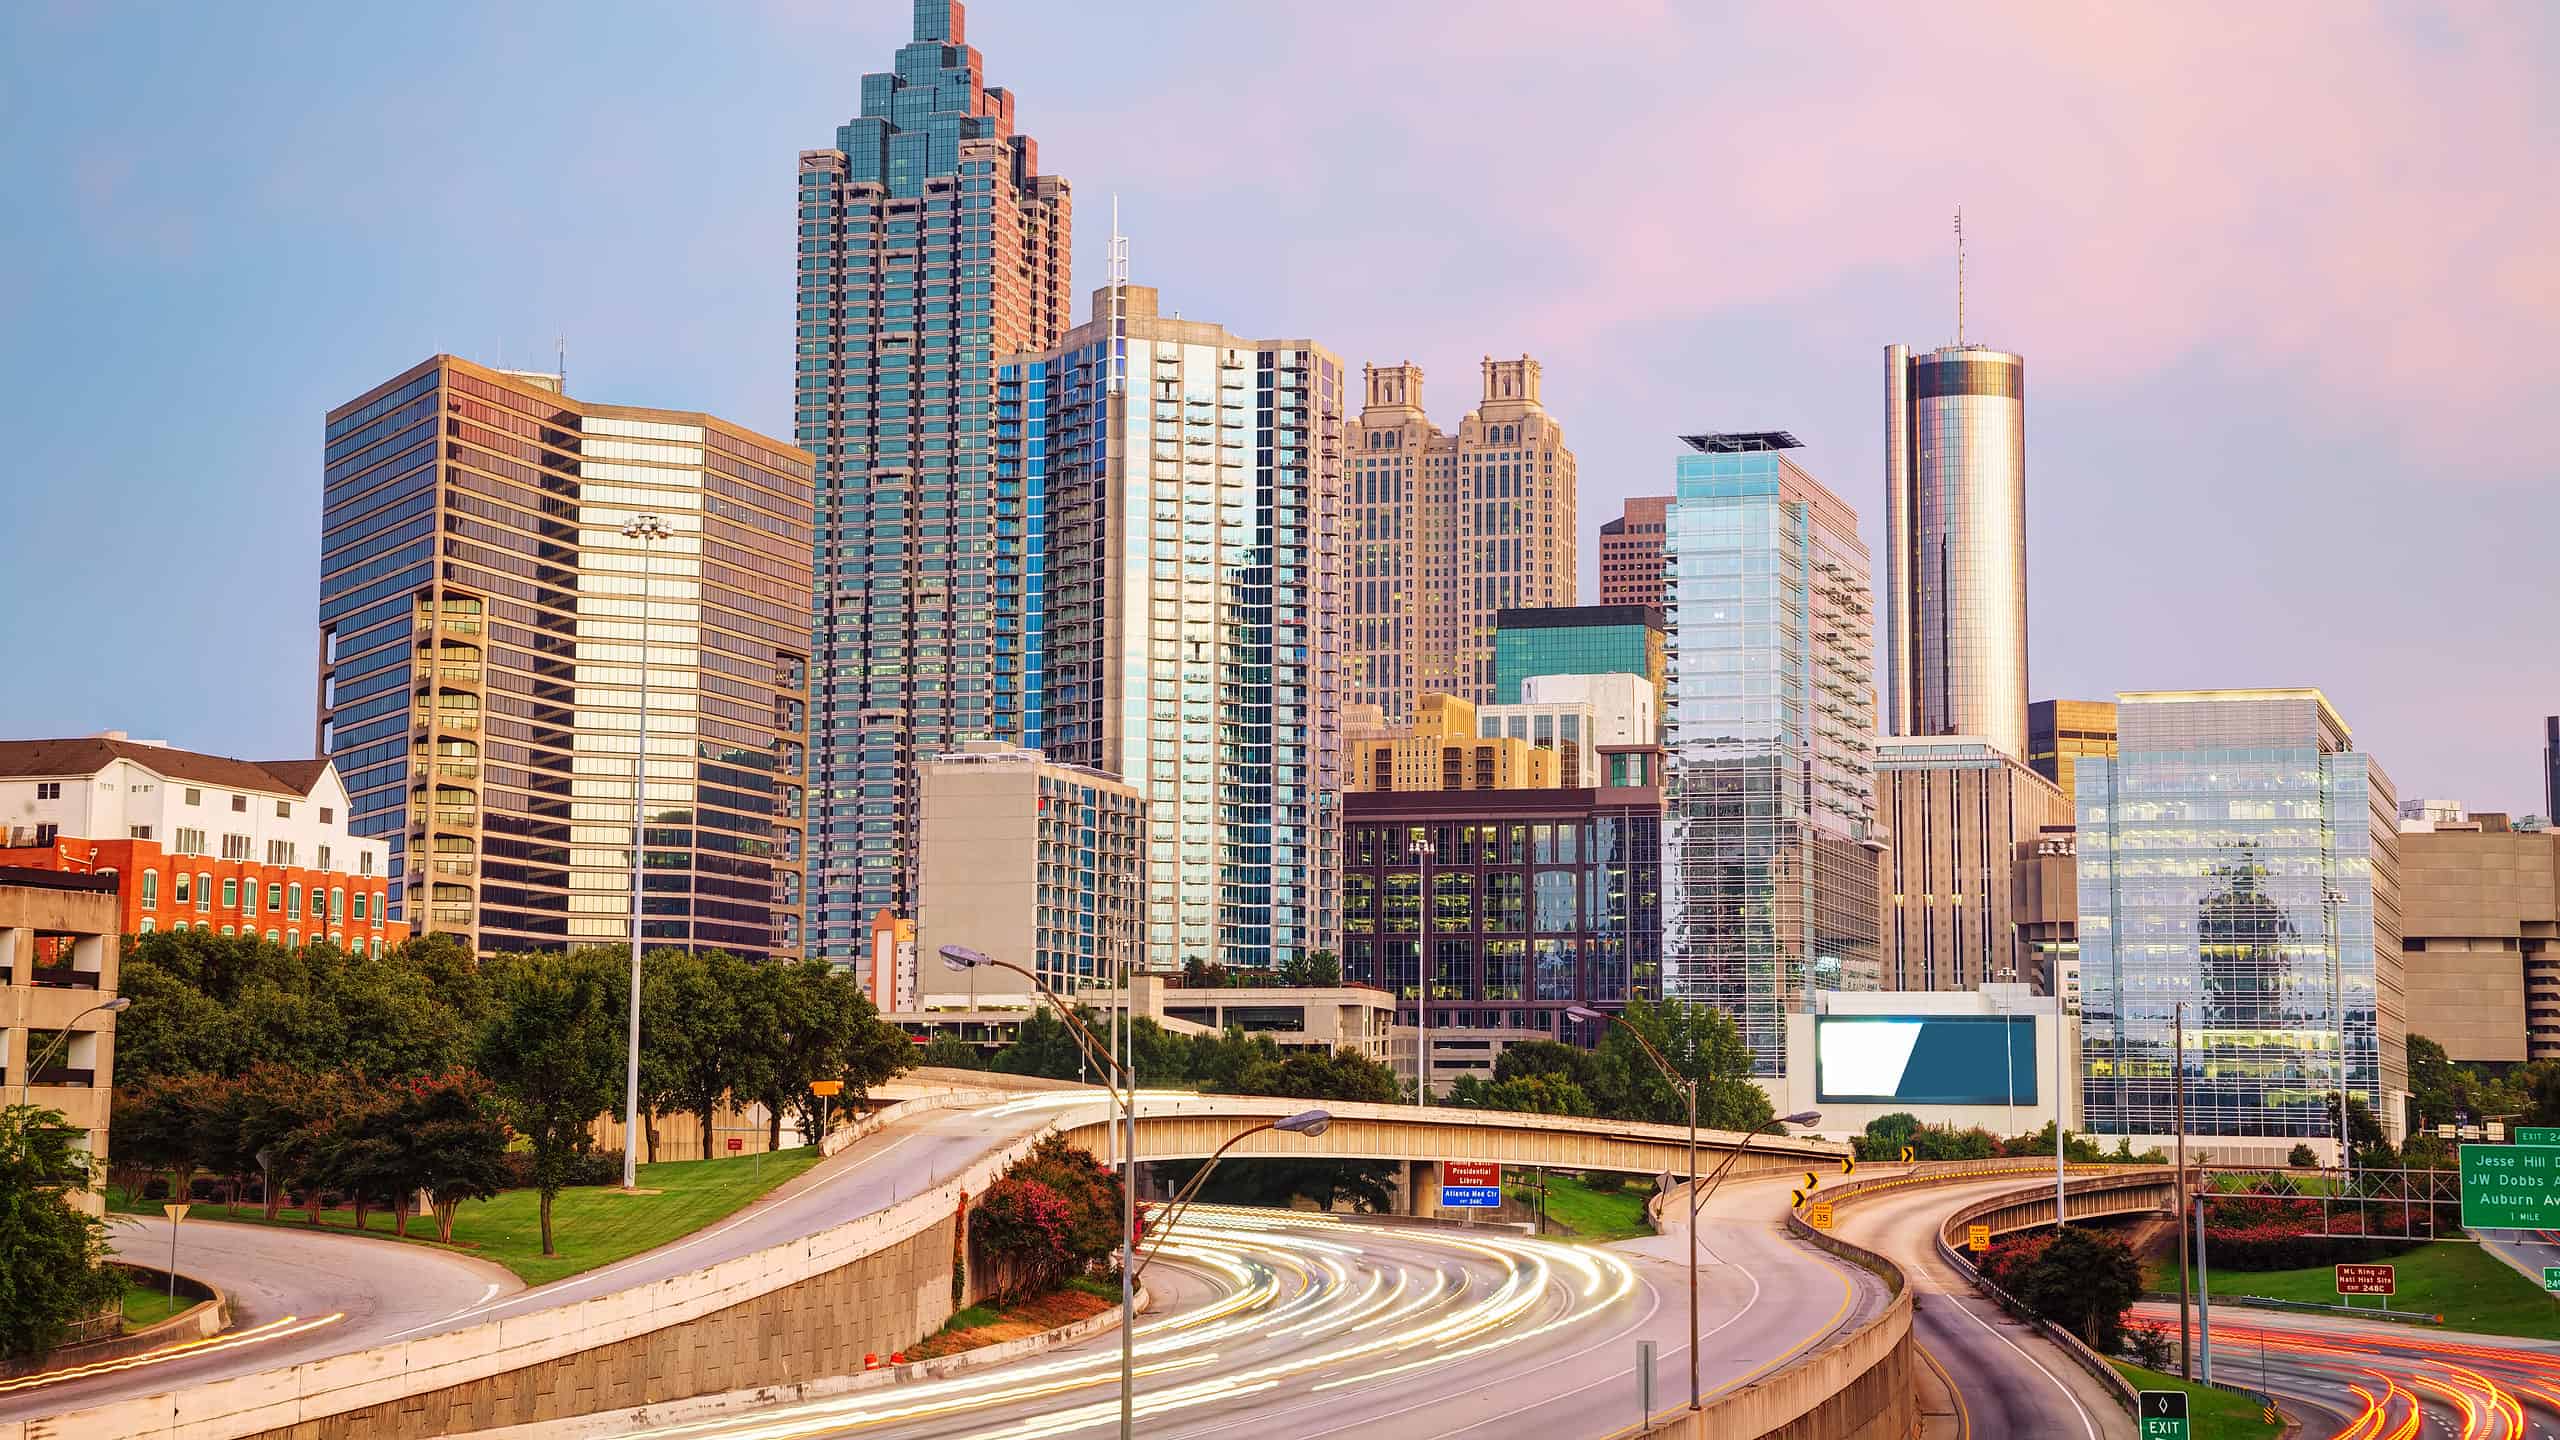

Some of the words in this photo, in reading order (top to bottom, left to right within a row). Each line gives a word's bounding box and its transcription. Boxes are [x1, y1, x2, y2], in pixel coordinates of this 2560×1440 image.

[2522, 1132, 2542, 1141] EXIT
[2475, 1154, 2515, 1168] Jesse
[2524, 1155, 2545, 1168] Hill
[1452, 1167, 1491, 1176] Presidential
[1459, 1177, 1483, 1185] Library
[2468, 1173, 2491, 1186] JW
[2499, 1174, 2544, 1187] Dobbs
[1445, 1190, 1470, 1198] Atlanta
[2480, 1192, 2534, 1206] Auburn
[1817, 1214, 1828, 1222] 35
[2520, 1212, 2540, 1221] MILE
[1974, 1236, 1986, 1244] 35
[2358, 1267, 2375, 1277] King
[2377, 1268, 2387, 1276] Jr
[2358, 1276, 2374, 1284] Hist
[2376, 1277, 2392, 1285] Site
[2150, 1421, 2179, 1434] EXIT
